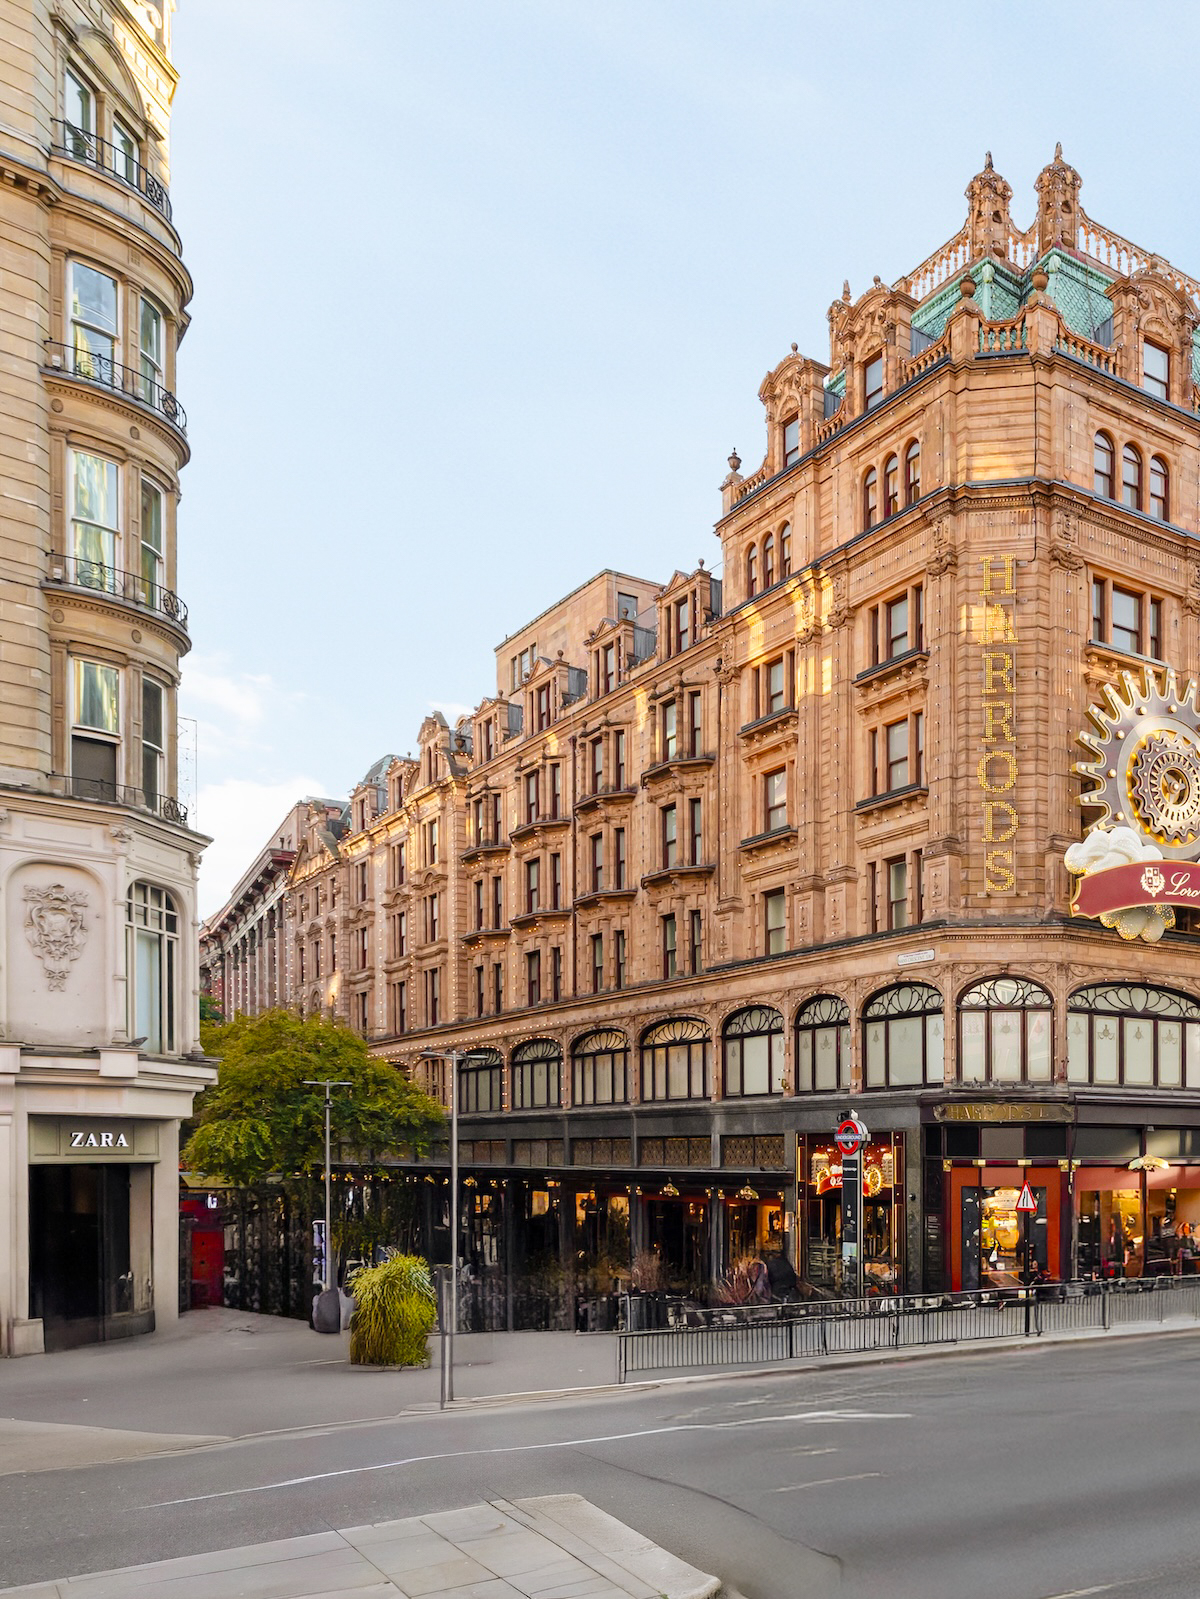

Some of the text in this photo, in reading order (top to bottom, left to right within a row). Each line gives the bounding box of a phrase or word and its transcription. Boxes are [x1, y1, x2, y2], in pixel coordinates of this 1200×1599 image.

[977, 553, 1020, 892] HARRODS
[1165, 872, 1200, 898] Loro
[70, 1132, 129, 1147] ZARA
